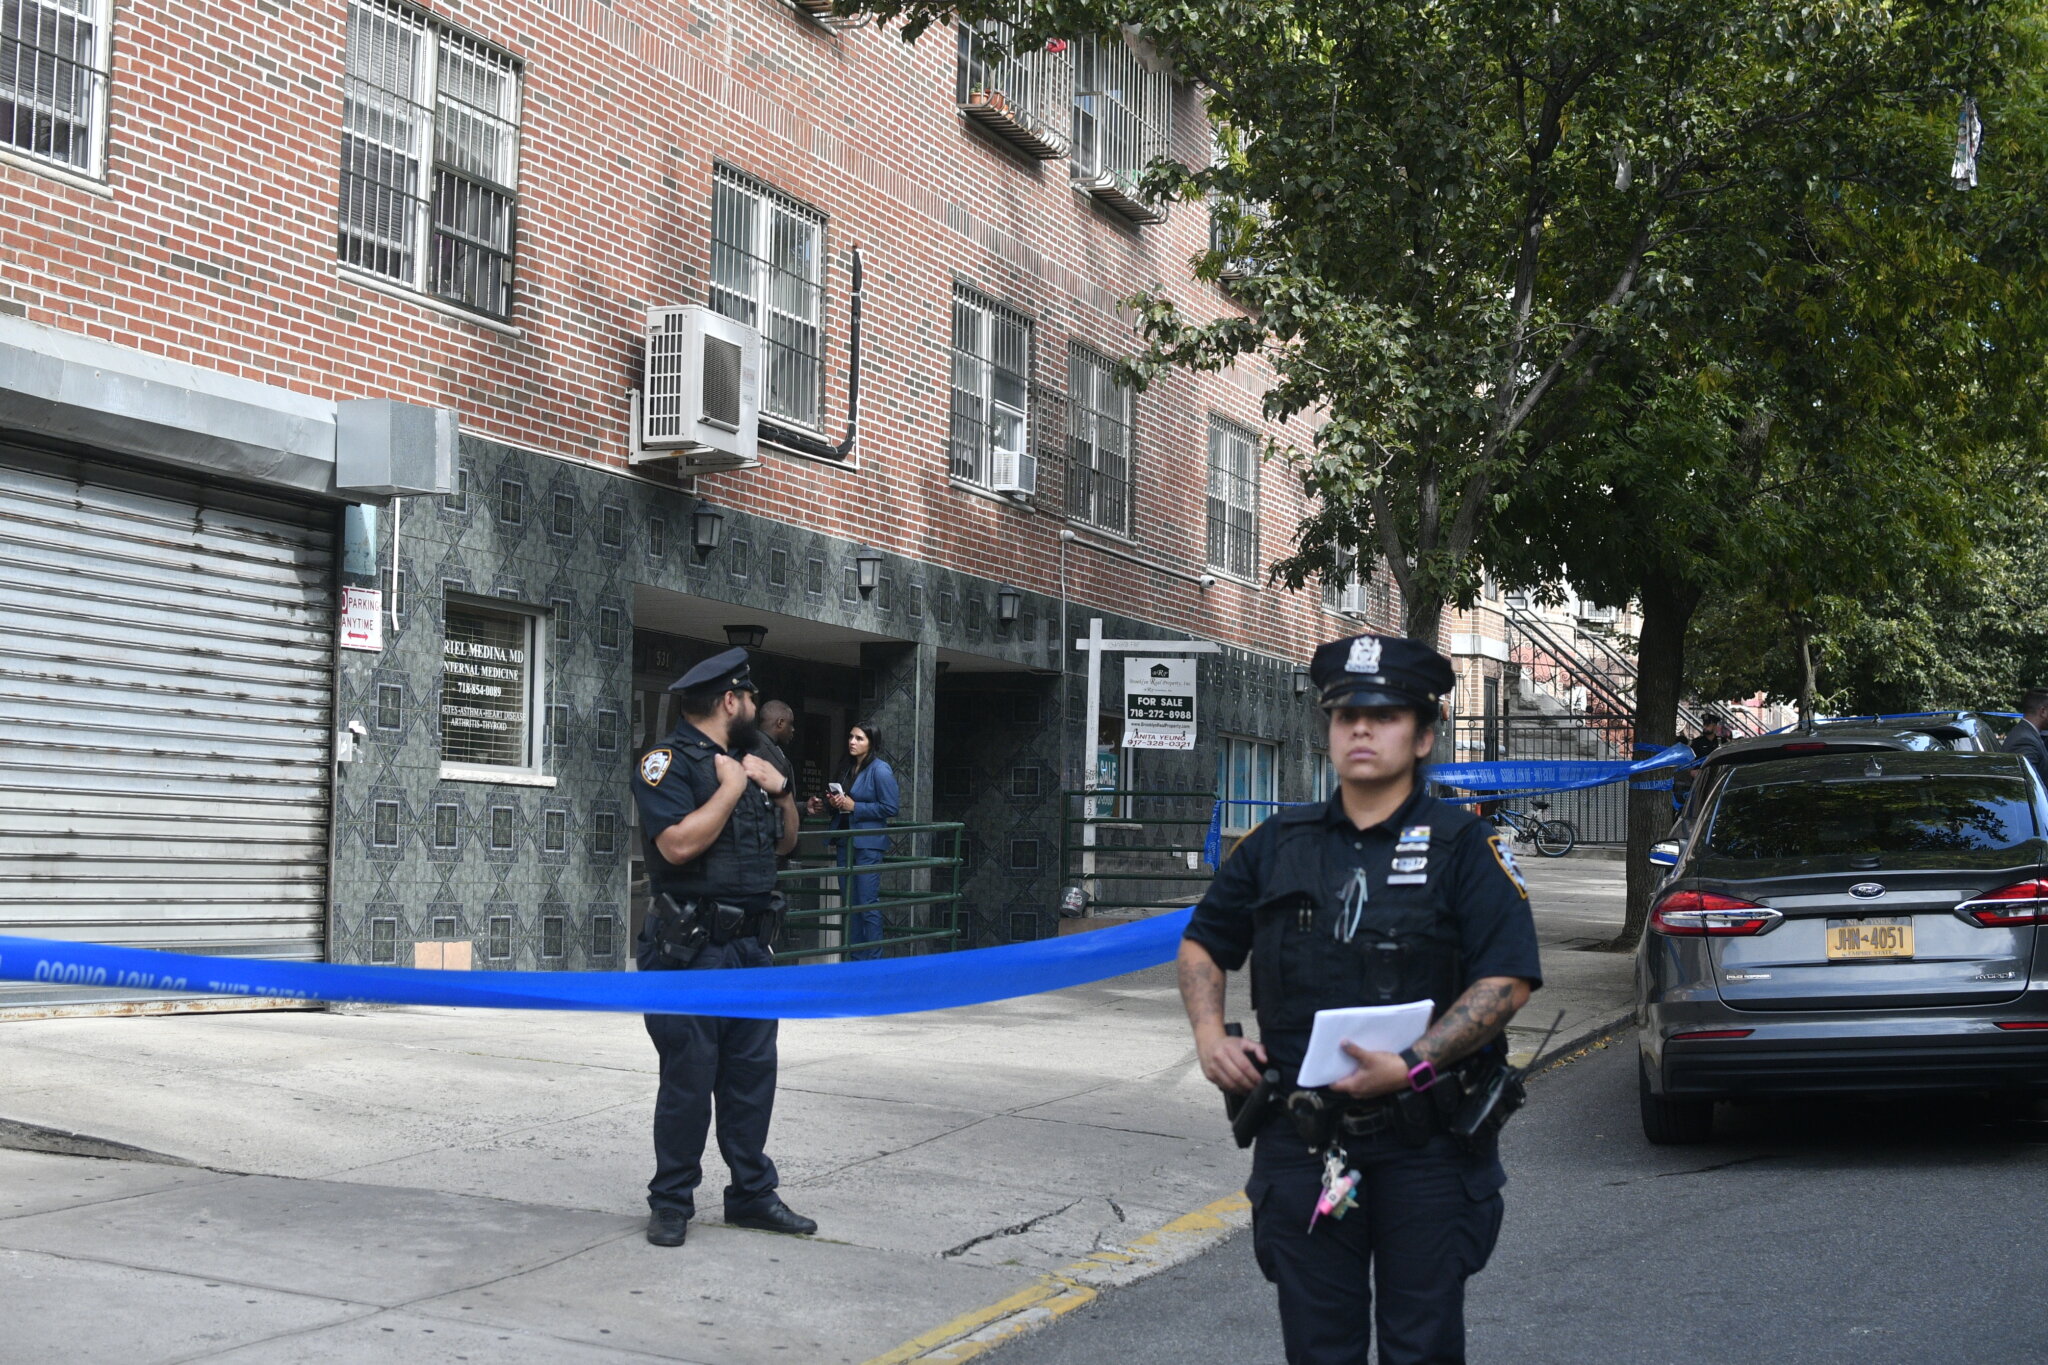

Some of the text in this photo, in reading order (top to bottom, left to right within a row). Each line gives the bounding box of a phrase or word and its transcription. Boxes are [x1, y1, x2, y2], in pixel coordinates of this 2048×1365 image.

[348, 597, 380, 612] PARKING
[341, 617, 374, 631] ANYTIME
[444, 640, 524, 663] RIEL MEDINA, MD
[443, 661, 519, 681] NTERNAL MEDICINE
[1137, 696, 1183, 707] FOR SALE
[1129, 708, 1192, 720] 718-272-8988
